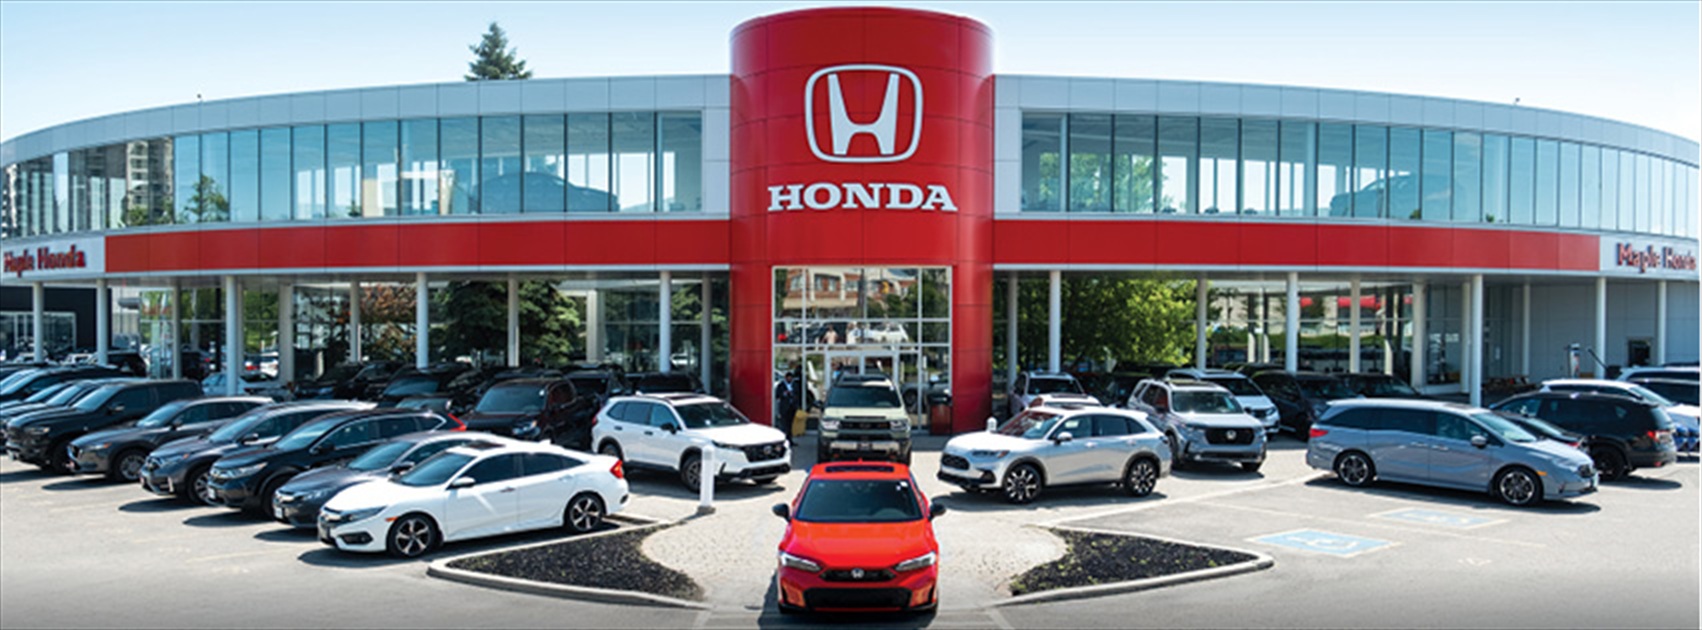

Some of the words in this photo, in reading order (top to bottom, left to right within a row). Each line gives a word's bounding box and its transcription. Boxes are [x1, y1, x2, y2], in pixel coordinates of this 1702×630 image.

[767, 182, 958, 212] HONDA
[37, 244, 86, 270] Honda
[1616, 243, 1661, 273] Maple
